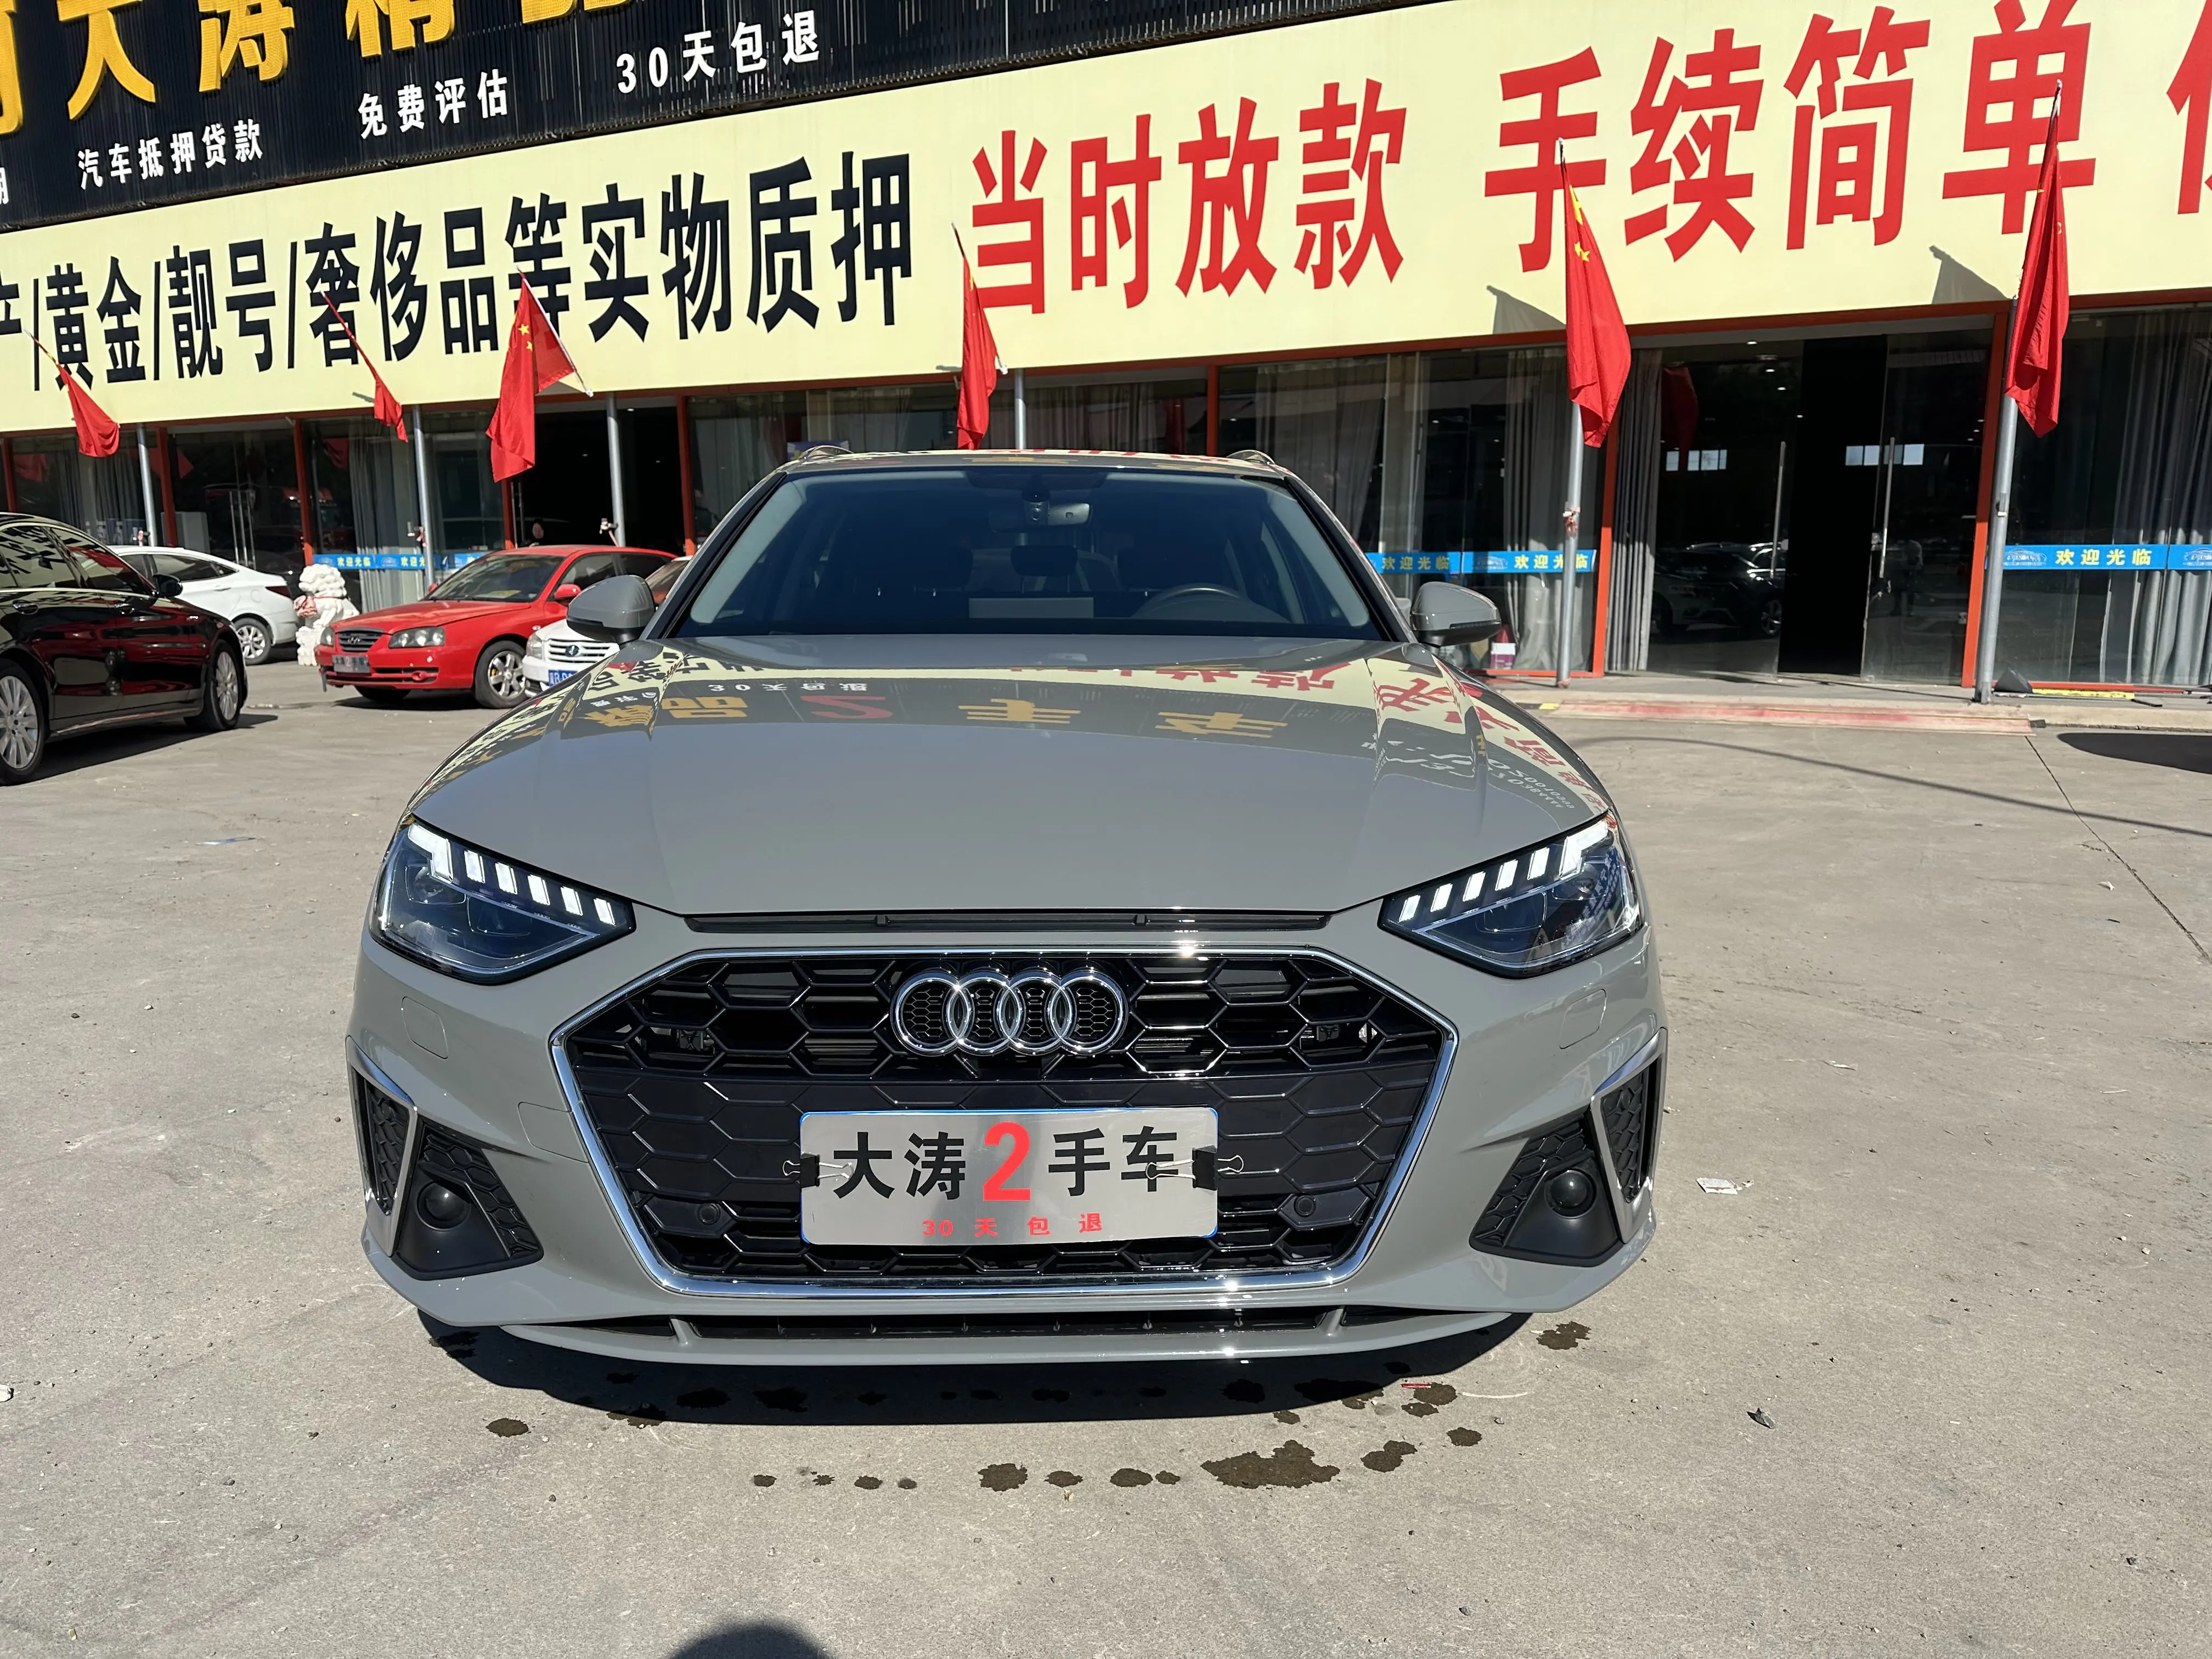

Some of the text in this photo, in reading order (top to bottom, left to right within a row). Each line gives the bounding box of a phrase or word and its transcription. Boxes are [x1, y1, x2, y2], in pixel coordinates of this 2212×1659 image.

[616, 10, 820, 94] 30天包退
[357, 69, 508, 140] 免费评估
[78, 118, 263, 190] 汽车抵押贷款
[972, 77, 1407, 314] 当时放款
[1484, 0, 2096, 273] 手续简单
[1382, 556, 1449, 570] 欢迎光临
[1514, 554, 1589, 569] 欢迎光临
[2055, 549, 2152, 566] 欢迎光临
[832, 1121, 1180, 1202] 大涛2手车
[922, 1212, 1103, 1238] 30天包退
